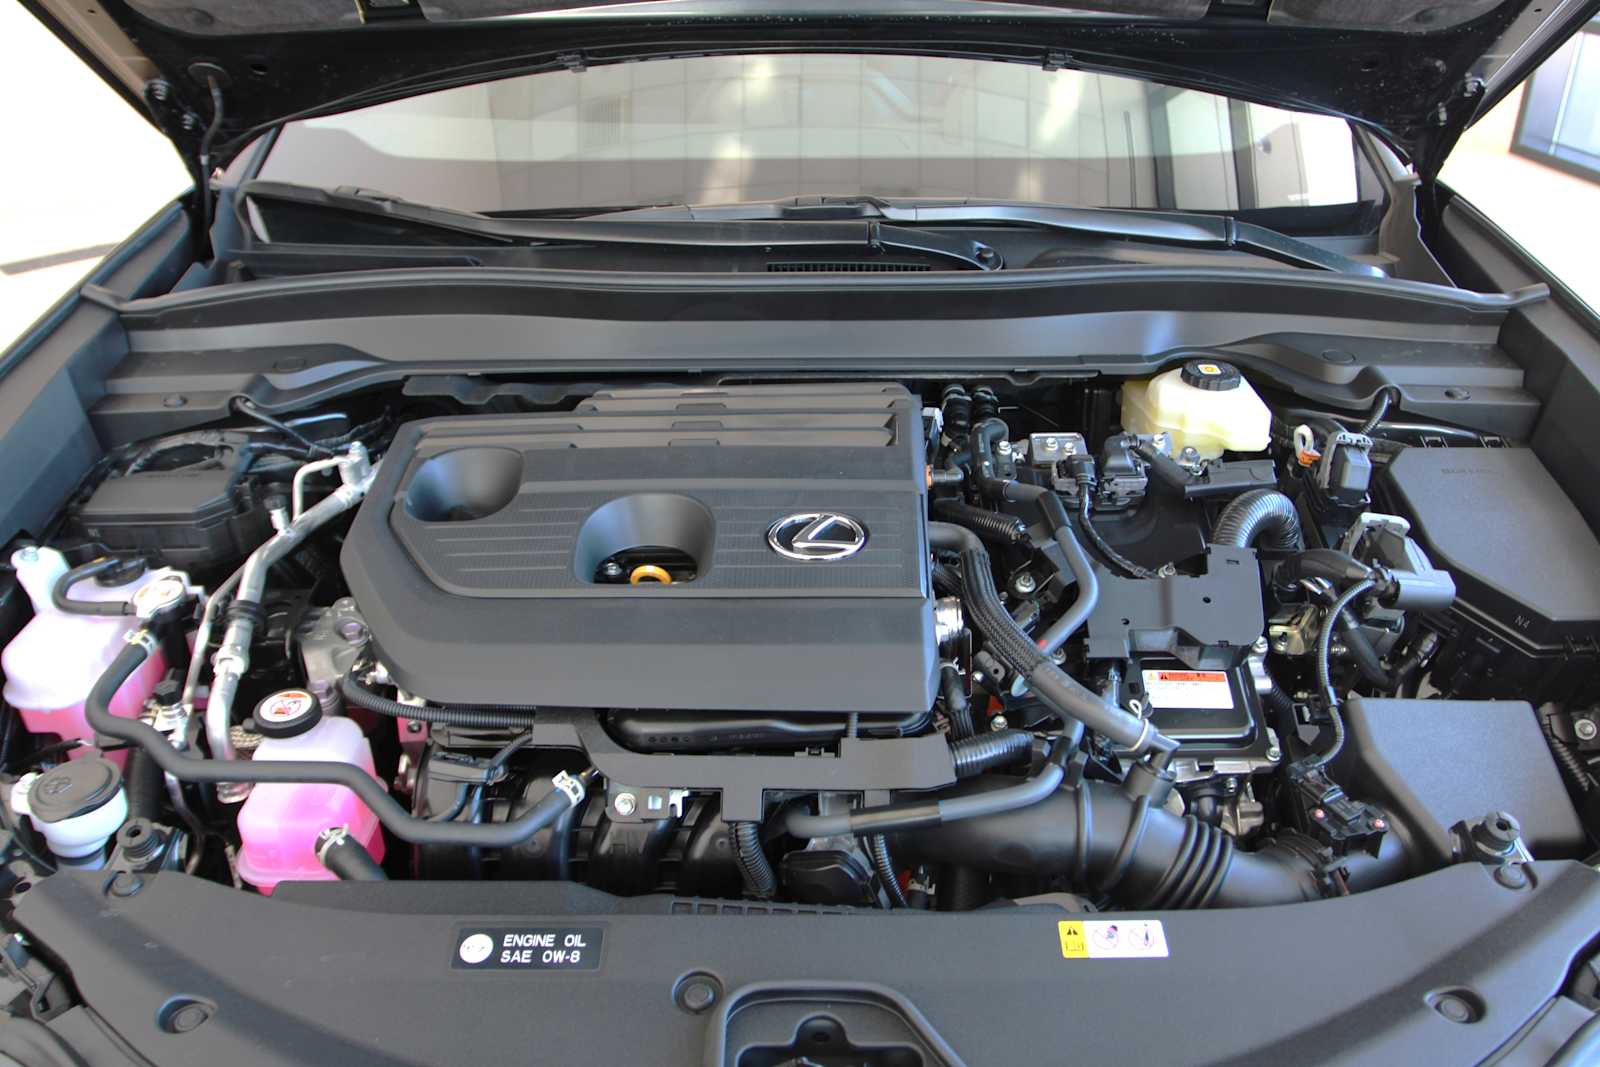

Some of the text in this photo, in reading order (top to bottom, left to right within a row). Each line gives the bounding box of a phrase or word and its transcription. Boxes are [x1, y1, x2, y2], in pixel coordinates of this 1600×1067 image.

[503, 934, 586, 947] ENGINE OIL
[500, 950, 581, 963] SAE 0W-8
